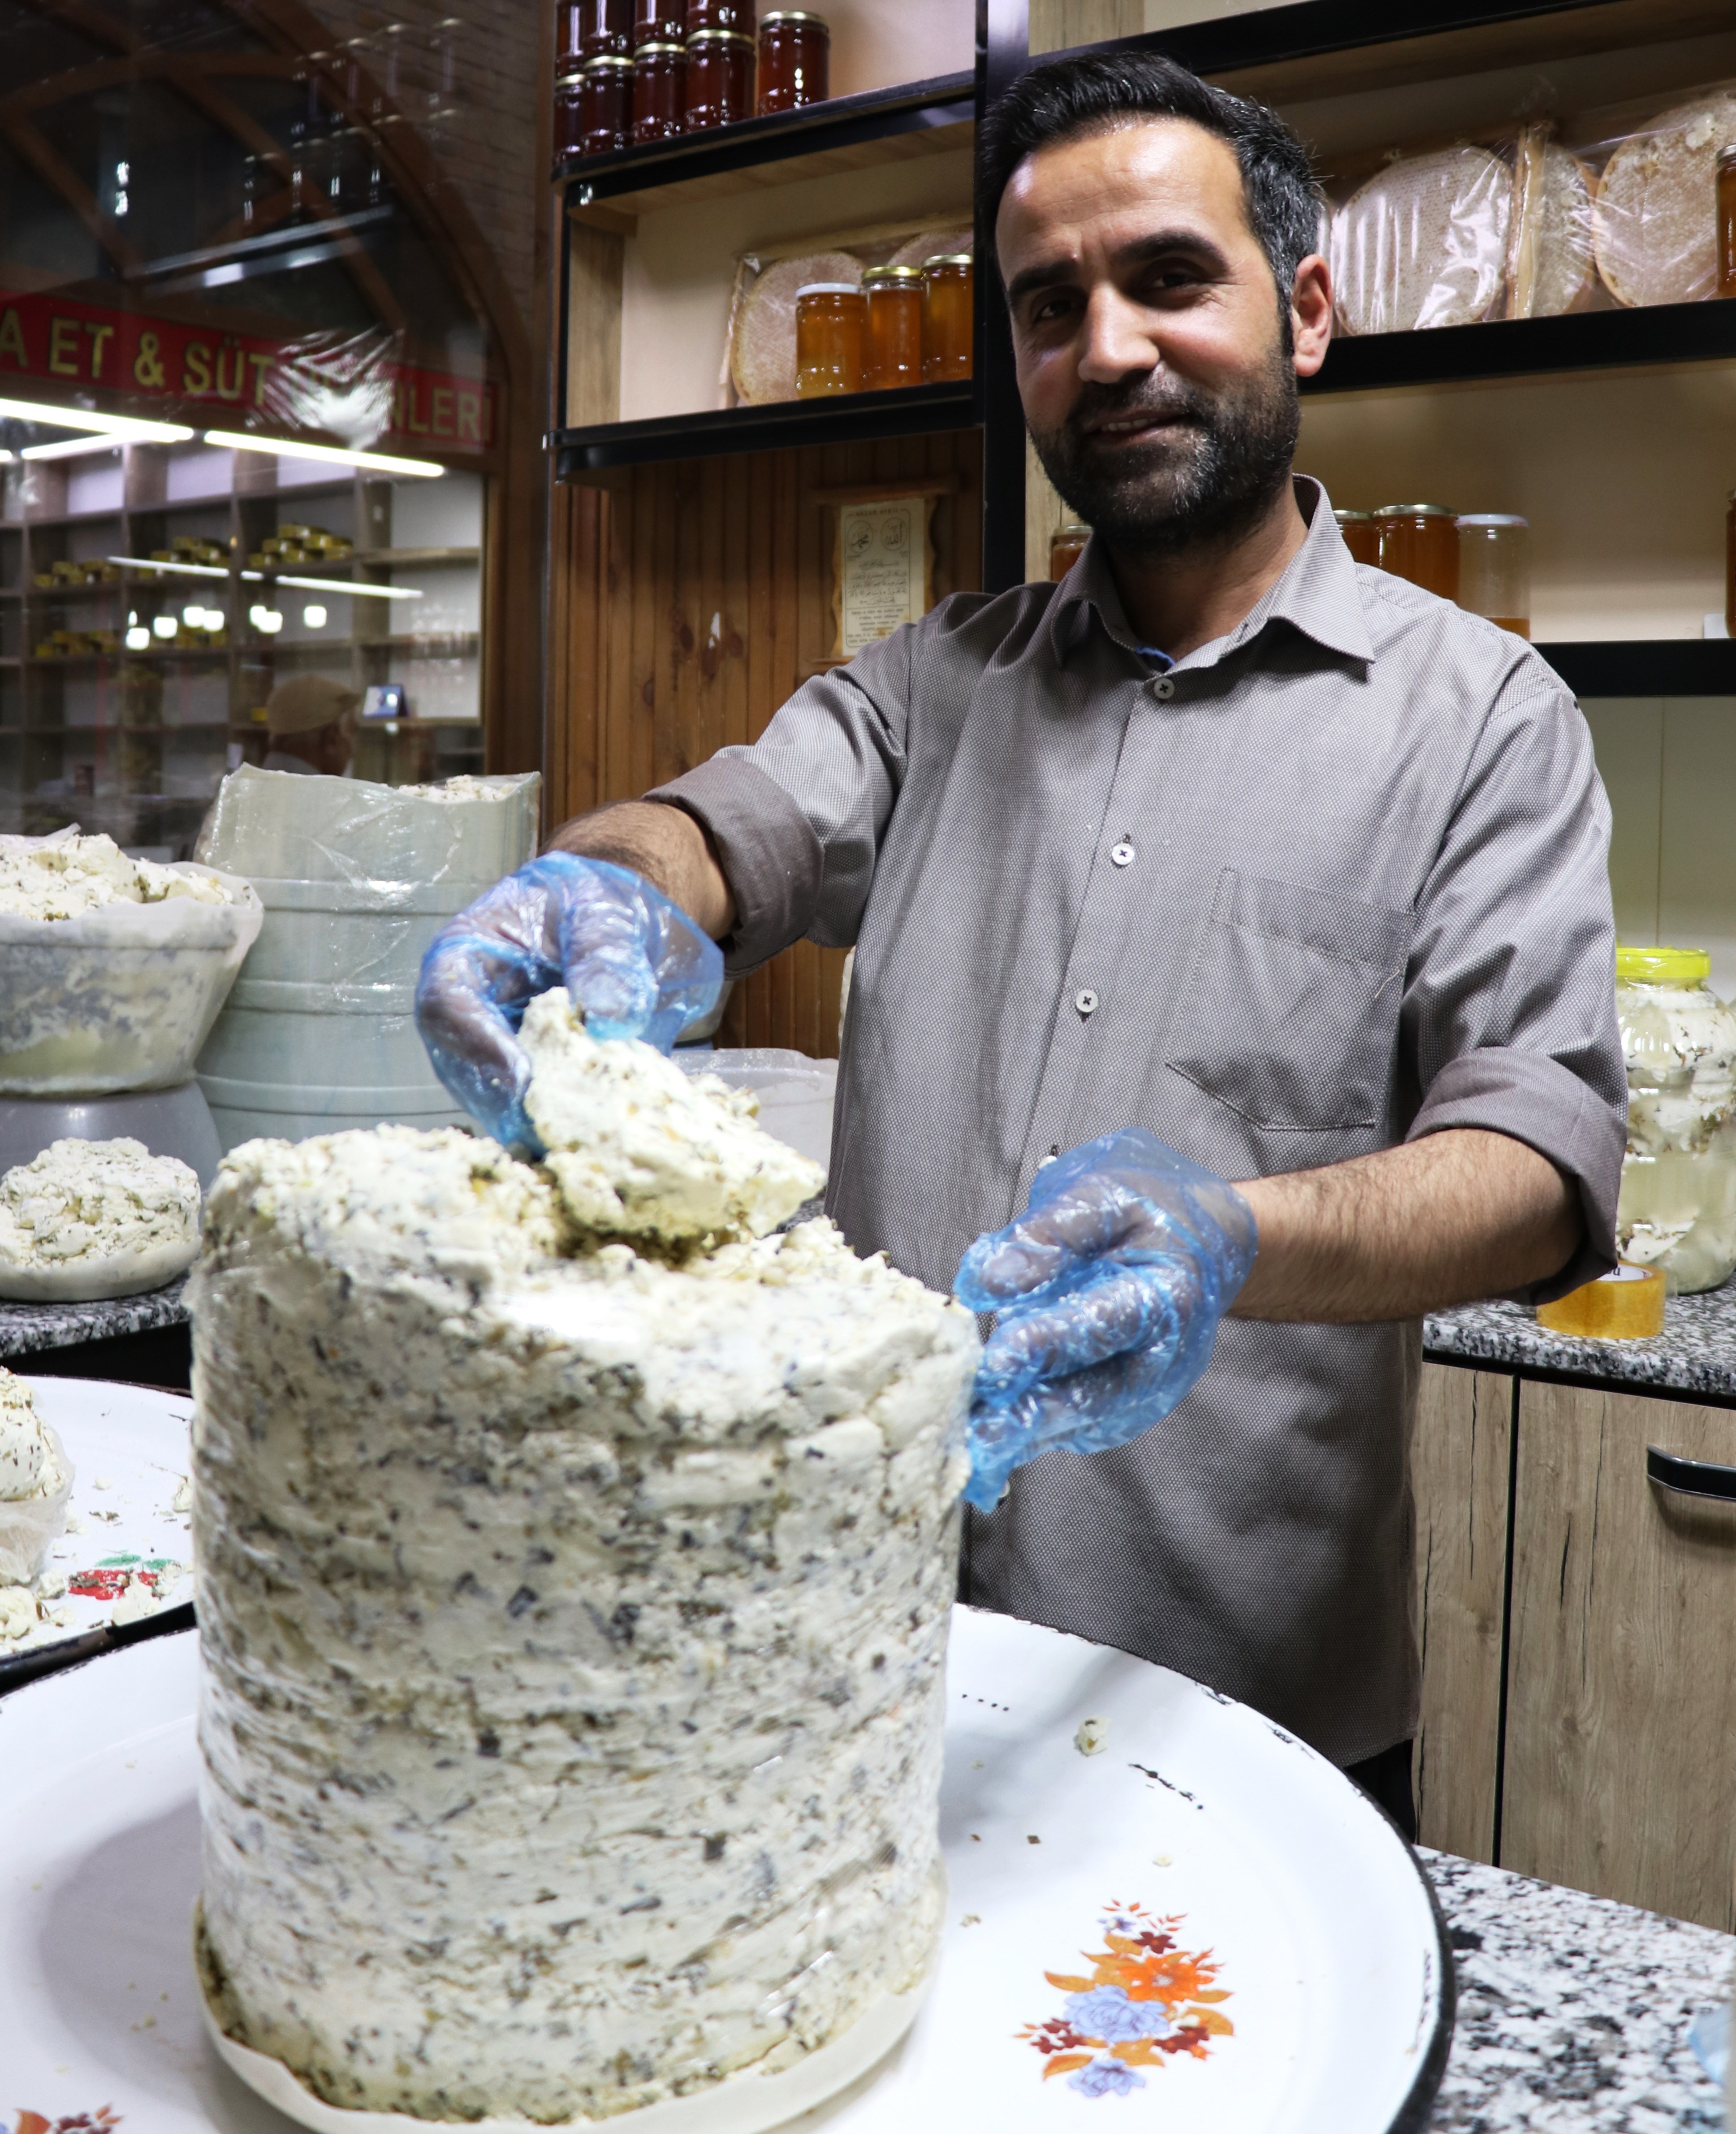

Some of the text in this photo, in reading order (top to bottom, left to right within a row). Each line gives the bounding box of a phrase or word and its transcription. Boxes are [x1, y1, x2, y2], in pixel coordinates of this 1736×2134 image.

[49, 316, 114, 379] ET
[134, 330, 165, 388] &
[182, 335, 276, 406] SÜT
